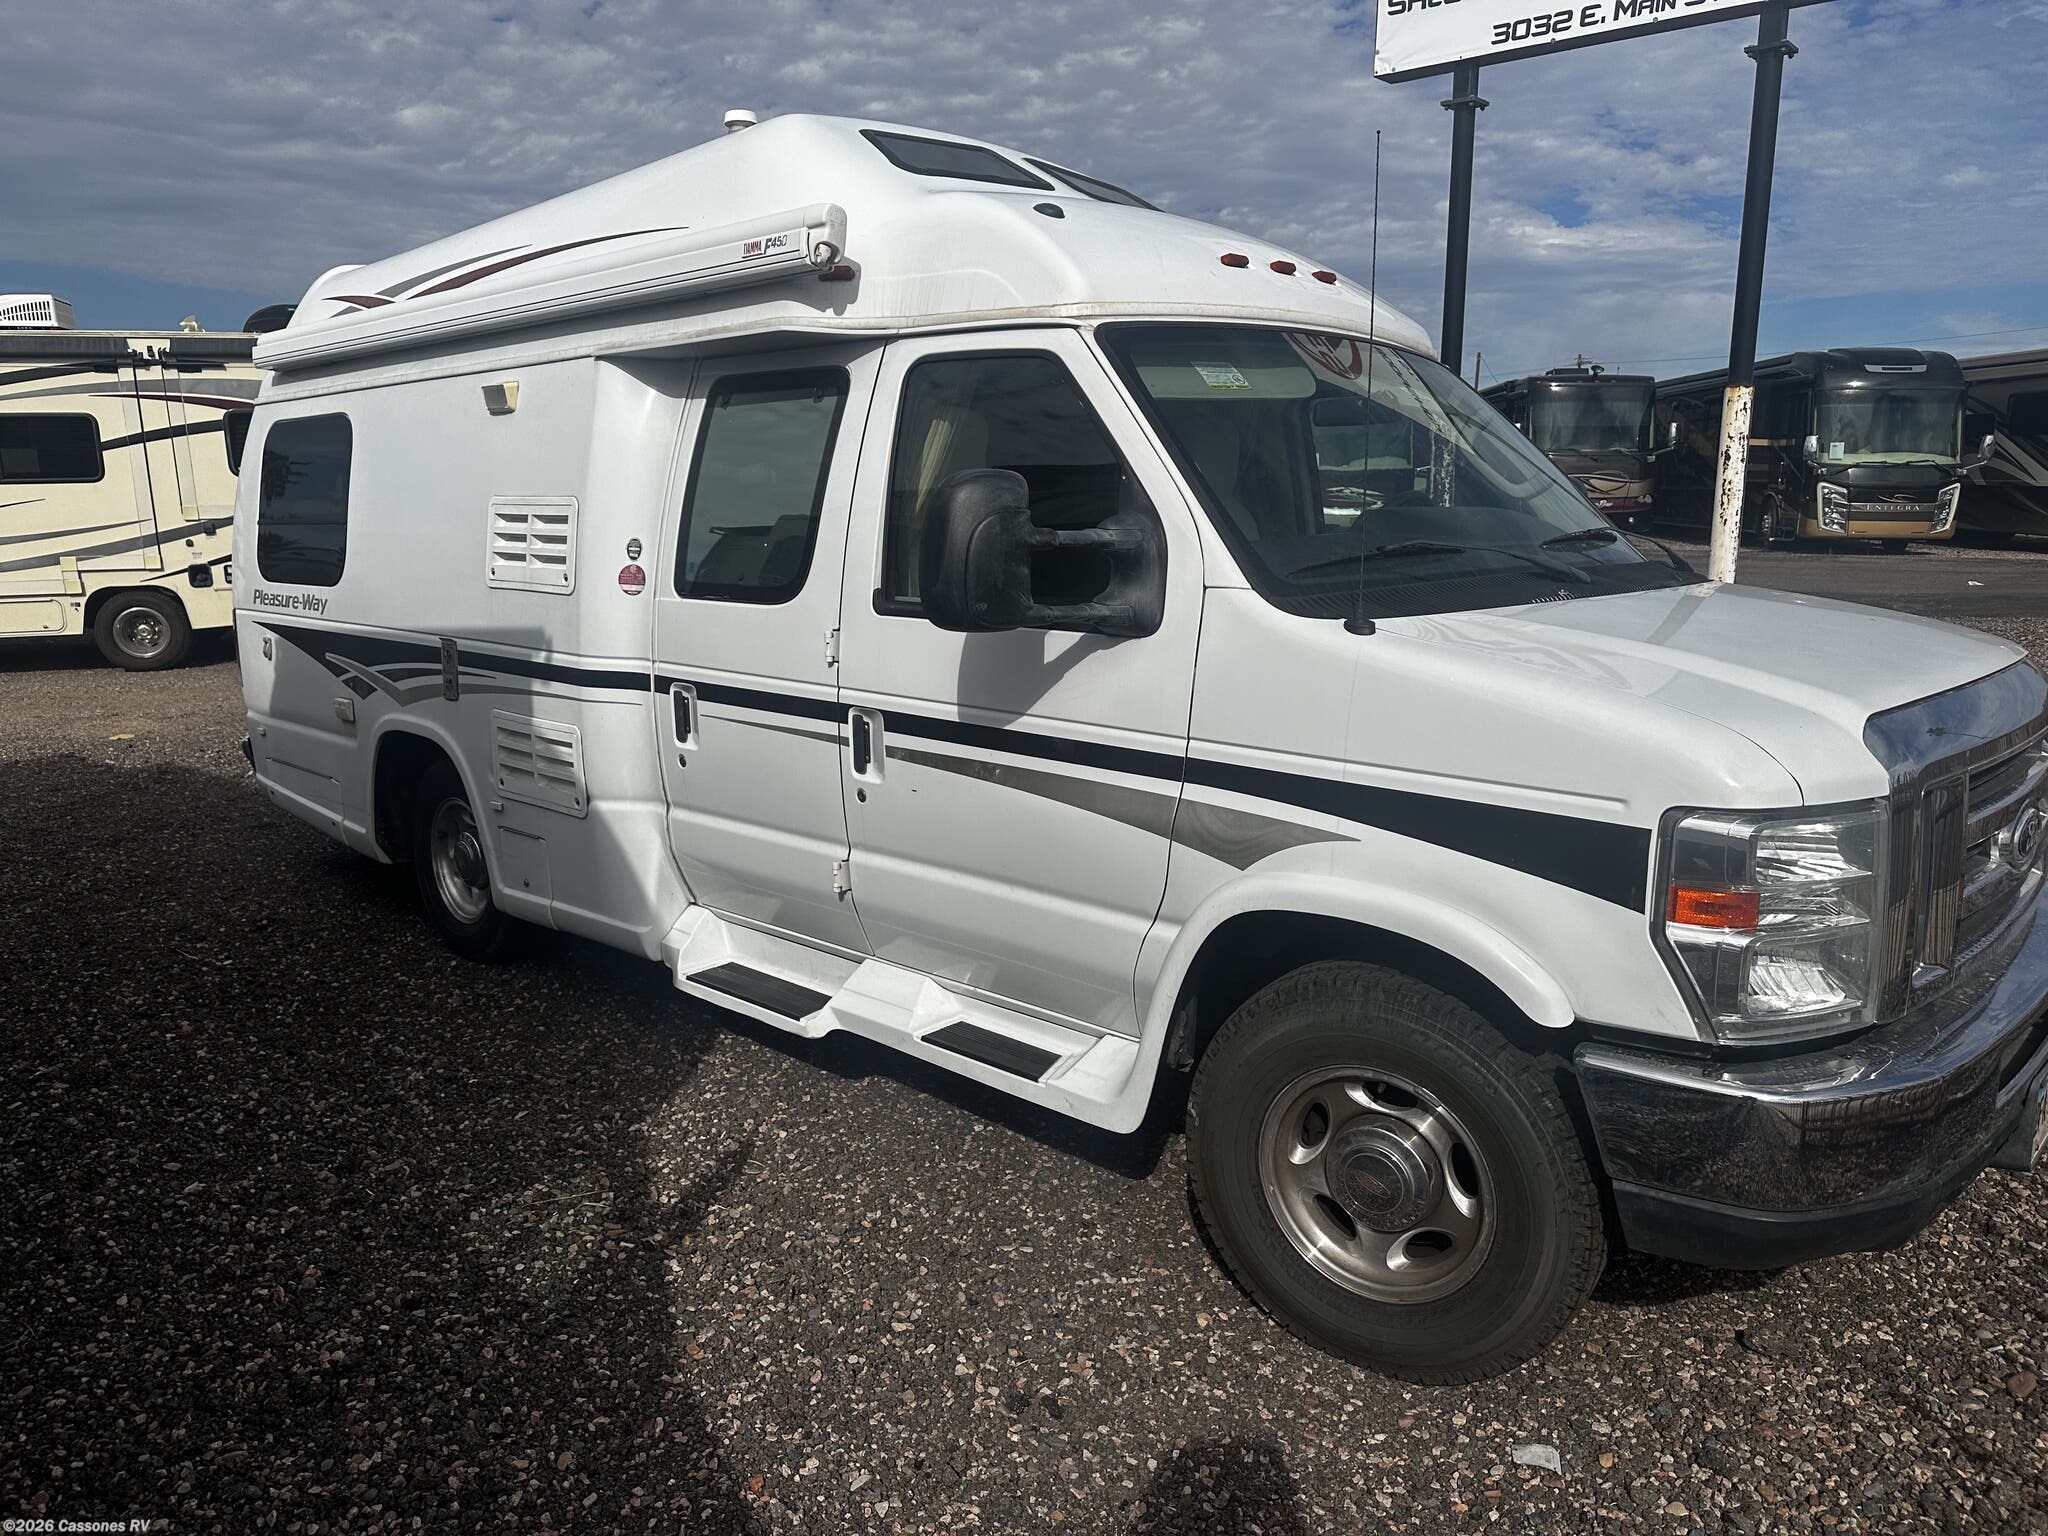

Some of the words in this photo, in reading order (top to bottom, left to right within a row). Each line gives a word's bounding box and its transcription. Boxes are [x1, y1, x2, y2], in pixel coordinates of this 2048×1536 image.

[1491, 9, 1573, 45] 3032
[1580, 4, 1606, 27] E.
[1613, 0, 1676, 21] MAIN
[764, 234, 788, 255] F450
[253, 589, 328, 615] Pleasure-Way
